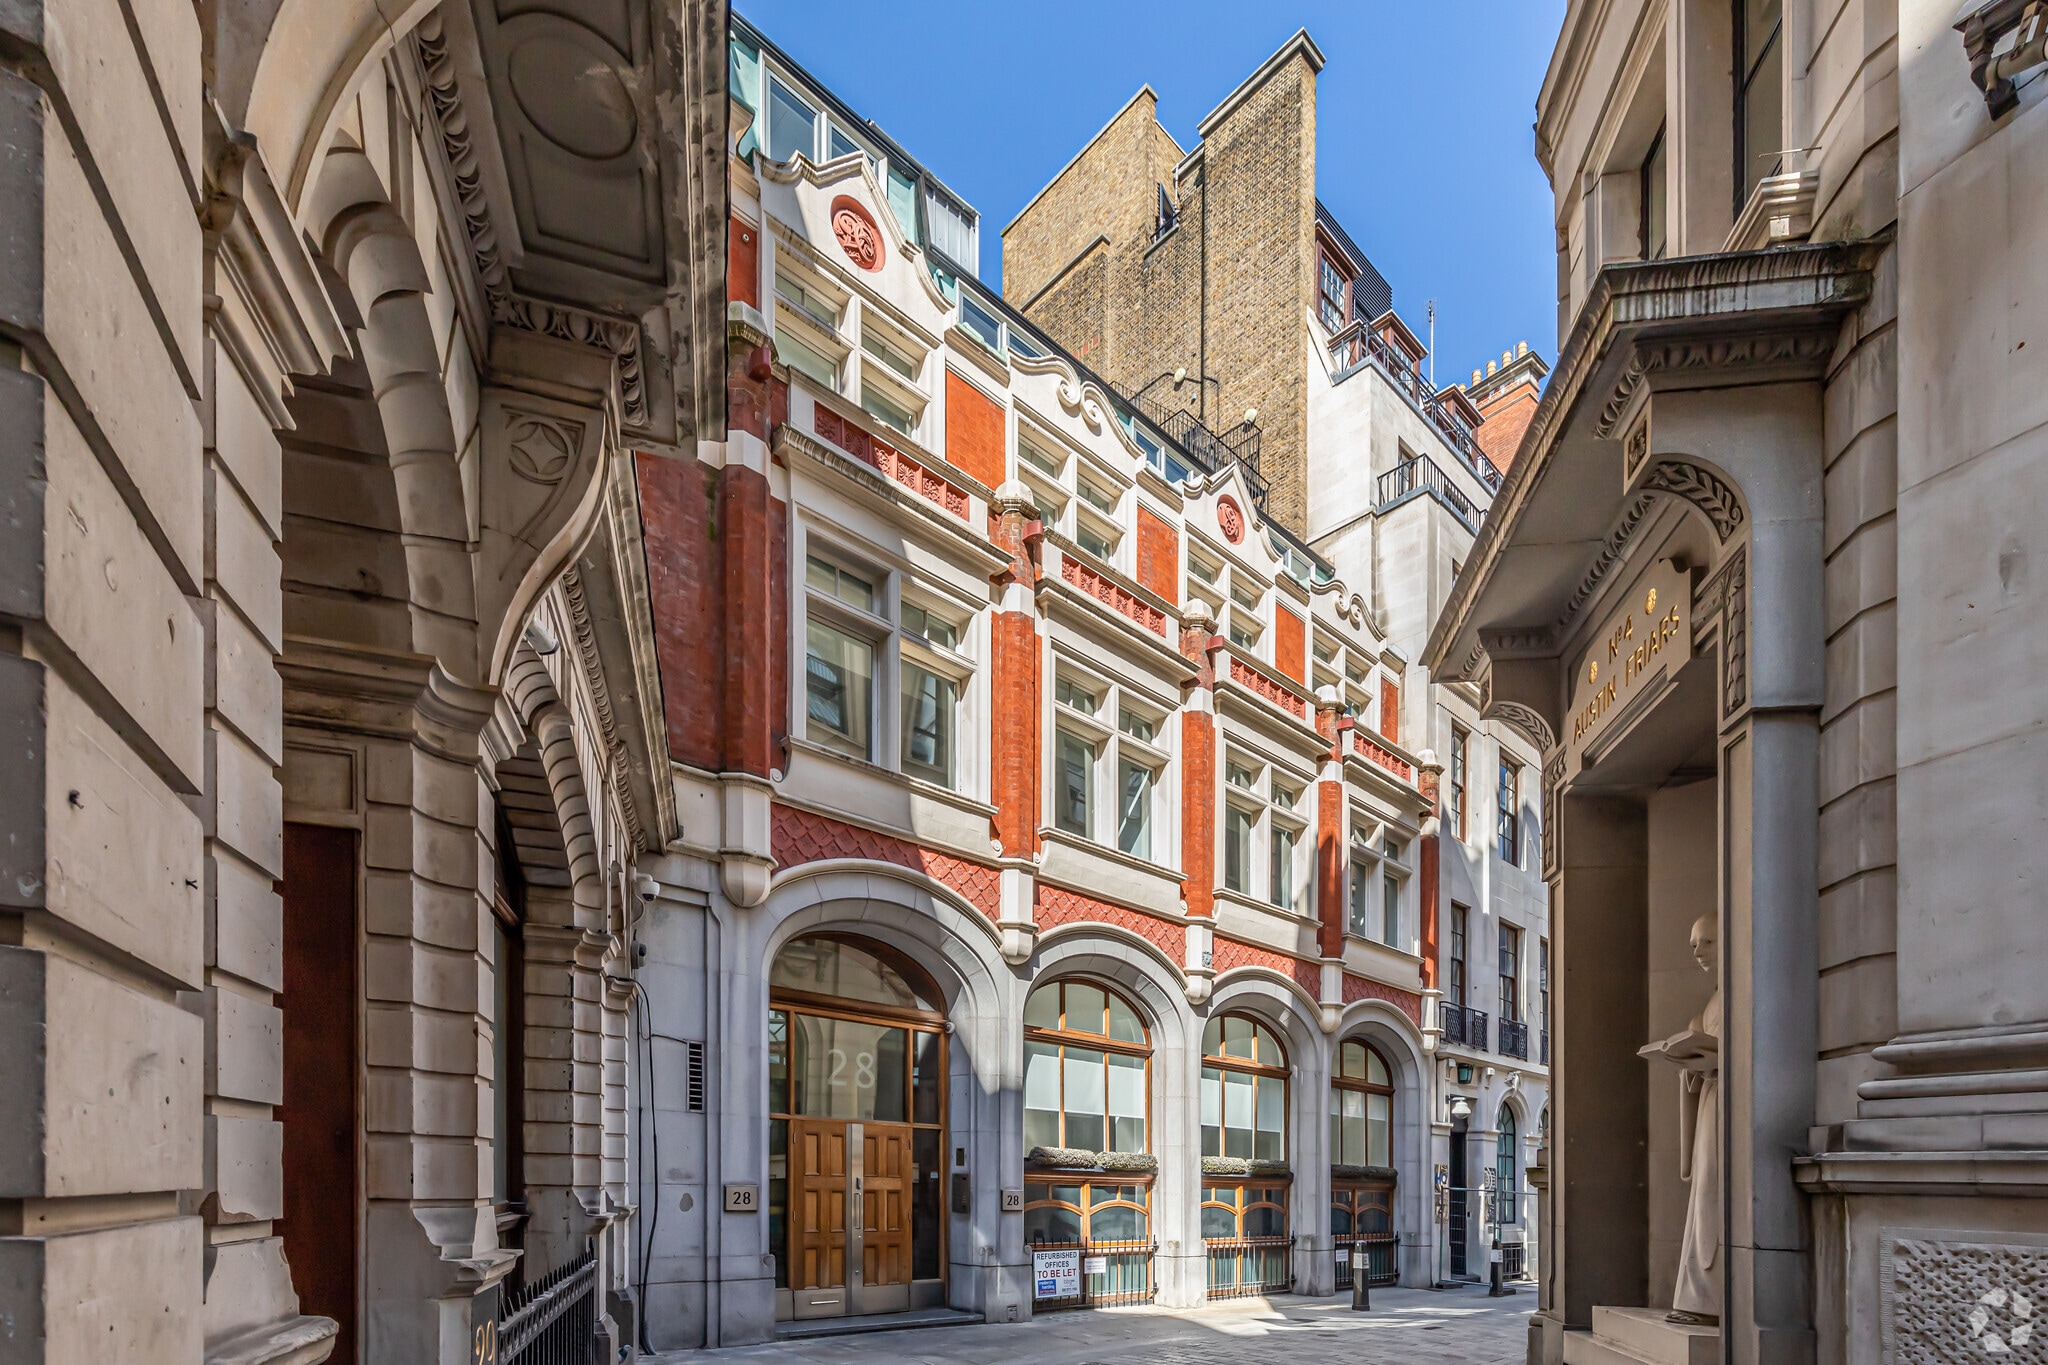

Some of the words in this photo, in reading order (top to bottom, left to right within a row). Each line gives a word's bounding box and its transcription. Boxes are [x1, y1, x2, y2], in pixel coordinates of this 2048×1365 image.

[1573, 675, 1617, 745] AUSTIN
[1625, 604, 1680, 687] FRIARS
[827, 1048, 876, 1089] 28
[733, 1191, 751, 1205] 28
[1007, 1194, 1020, 1206] 28
[1036, 1252, 1077, 1260] REFURBISHED
[1037, 1270, 1048, 1278] TO
[1050, 1269, 1061, 1278] BE
[1063, 1268, 1077, 1277] LET
